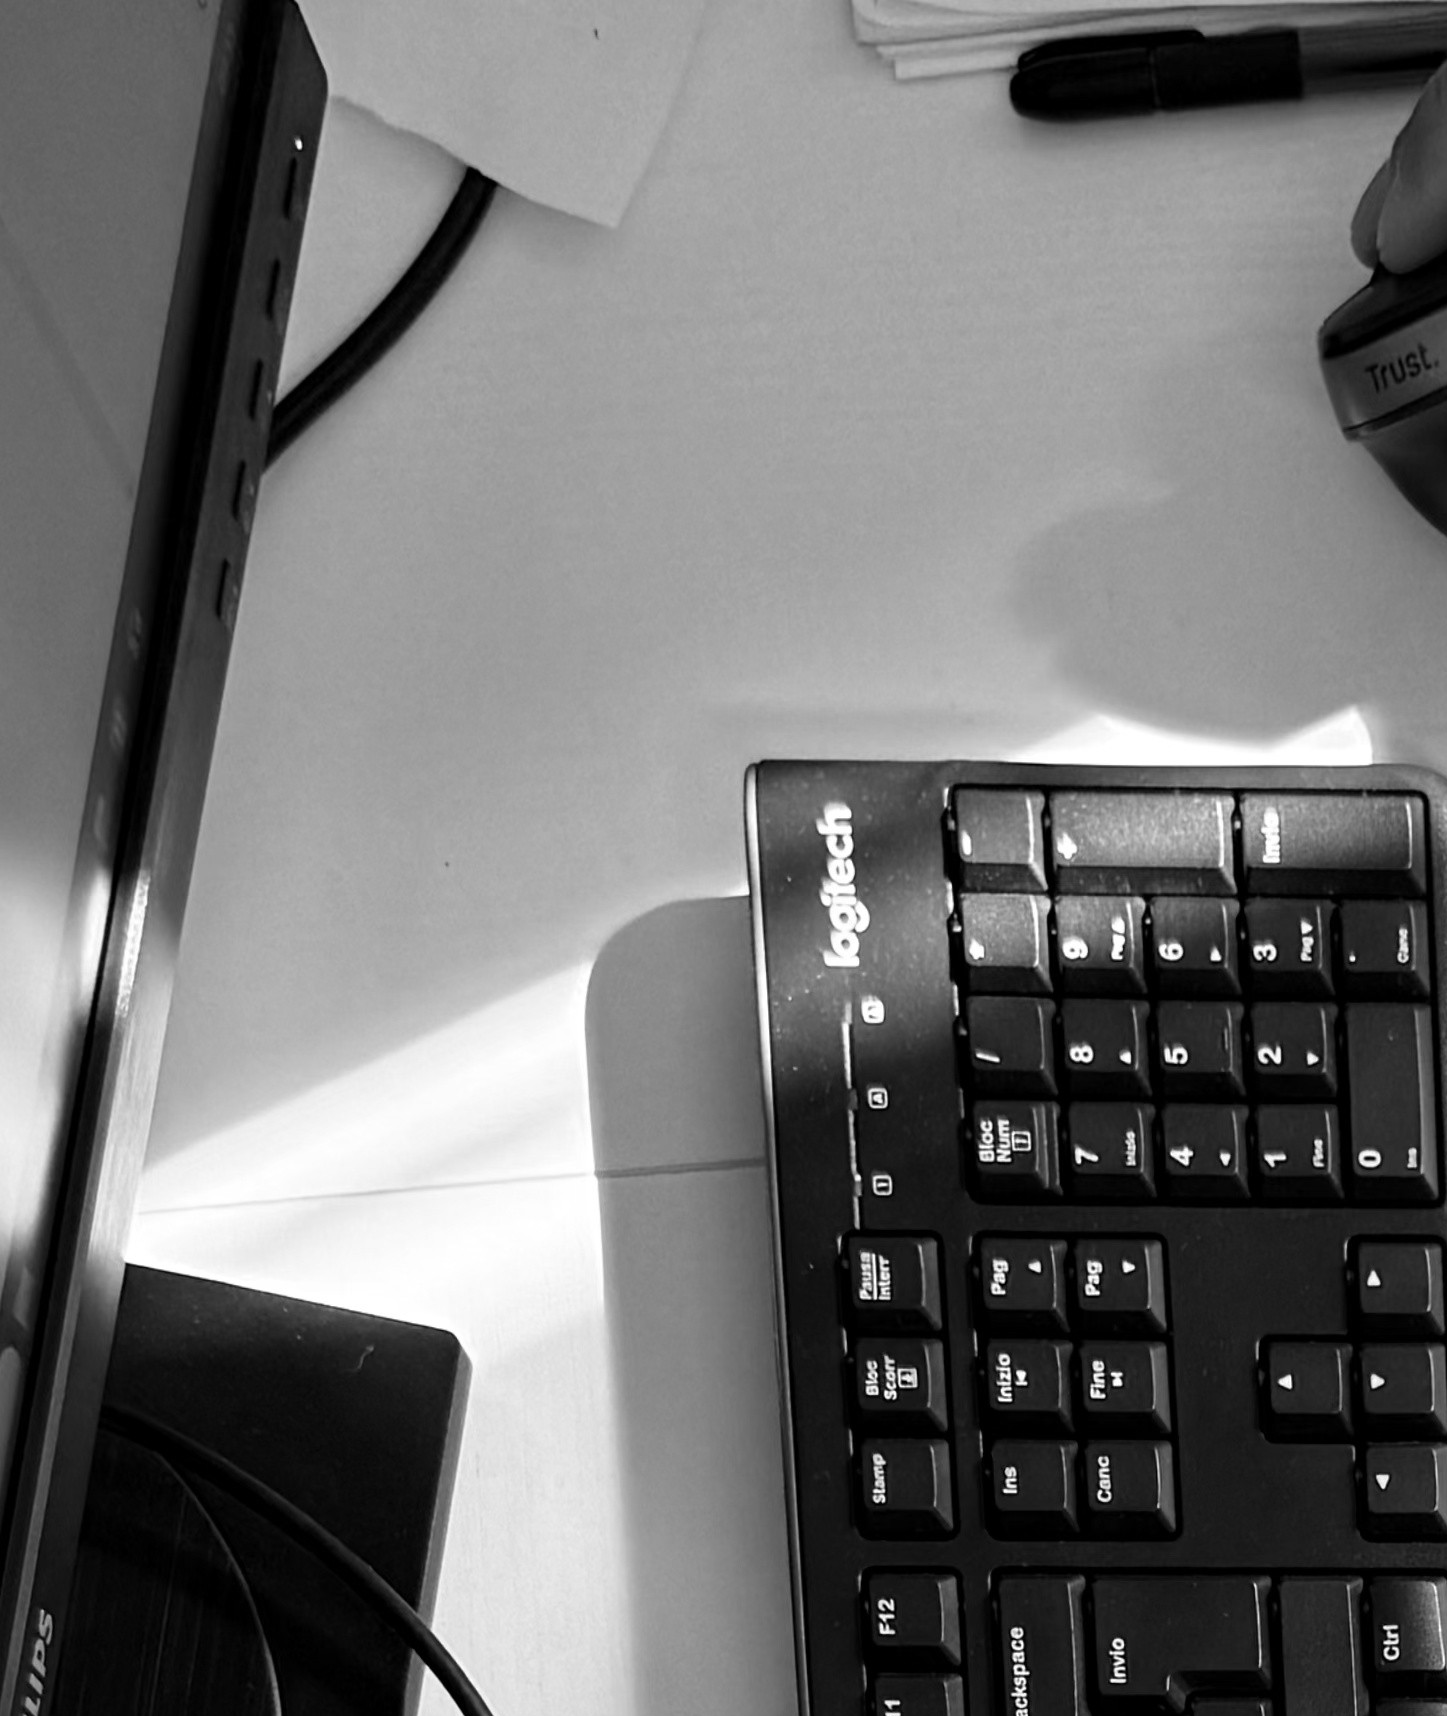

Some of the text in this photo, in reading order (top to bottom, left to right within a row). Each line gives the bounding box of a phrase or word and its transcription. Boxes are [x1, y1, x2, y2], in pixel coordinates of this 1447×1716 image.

[816, 802, 871, 968] logitech
[1062, 938, 1088, 960] 9
[1253, 943, 1277, 961] 3
[1397, 927, 1409, 964] Canc
[978, 1120, 995, 1162] Bloc
[996, 1119, 1012, 1163] Num
[1075, 1146, 1099, 1165] 7
[1358, 1149, 1382, 1168] 0
[1263, 1153, 1287, 1168] 1
[858, 1250, 873, 1300] Pausa
[990, 1259, 1009, 1295] Pag
[1084, 1260, 1103, 1296] Pag
[865, 1360, 880, 1396] Bloc
[883, 1355, 898, 1401] Scorr
[995, 1353, 1013, 1403] Inizio
[1089, 1360, 1106, 1399] Fine
[872, 1453, 887, 1504] Stamp
[1002, 1466, 1018, 1494] Ins
[1096, 1456, 1112, 1503] Canc
[877, 1598, 896, 1635] F12
[1108, 1637, 1127, 1684] Invio
[1382, 1624, 1400, 1661] Ctrl
